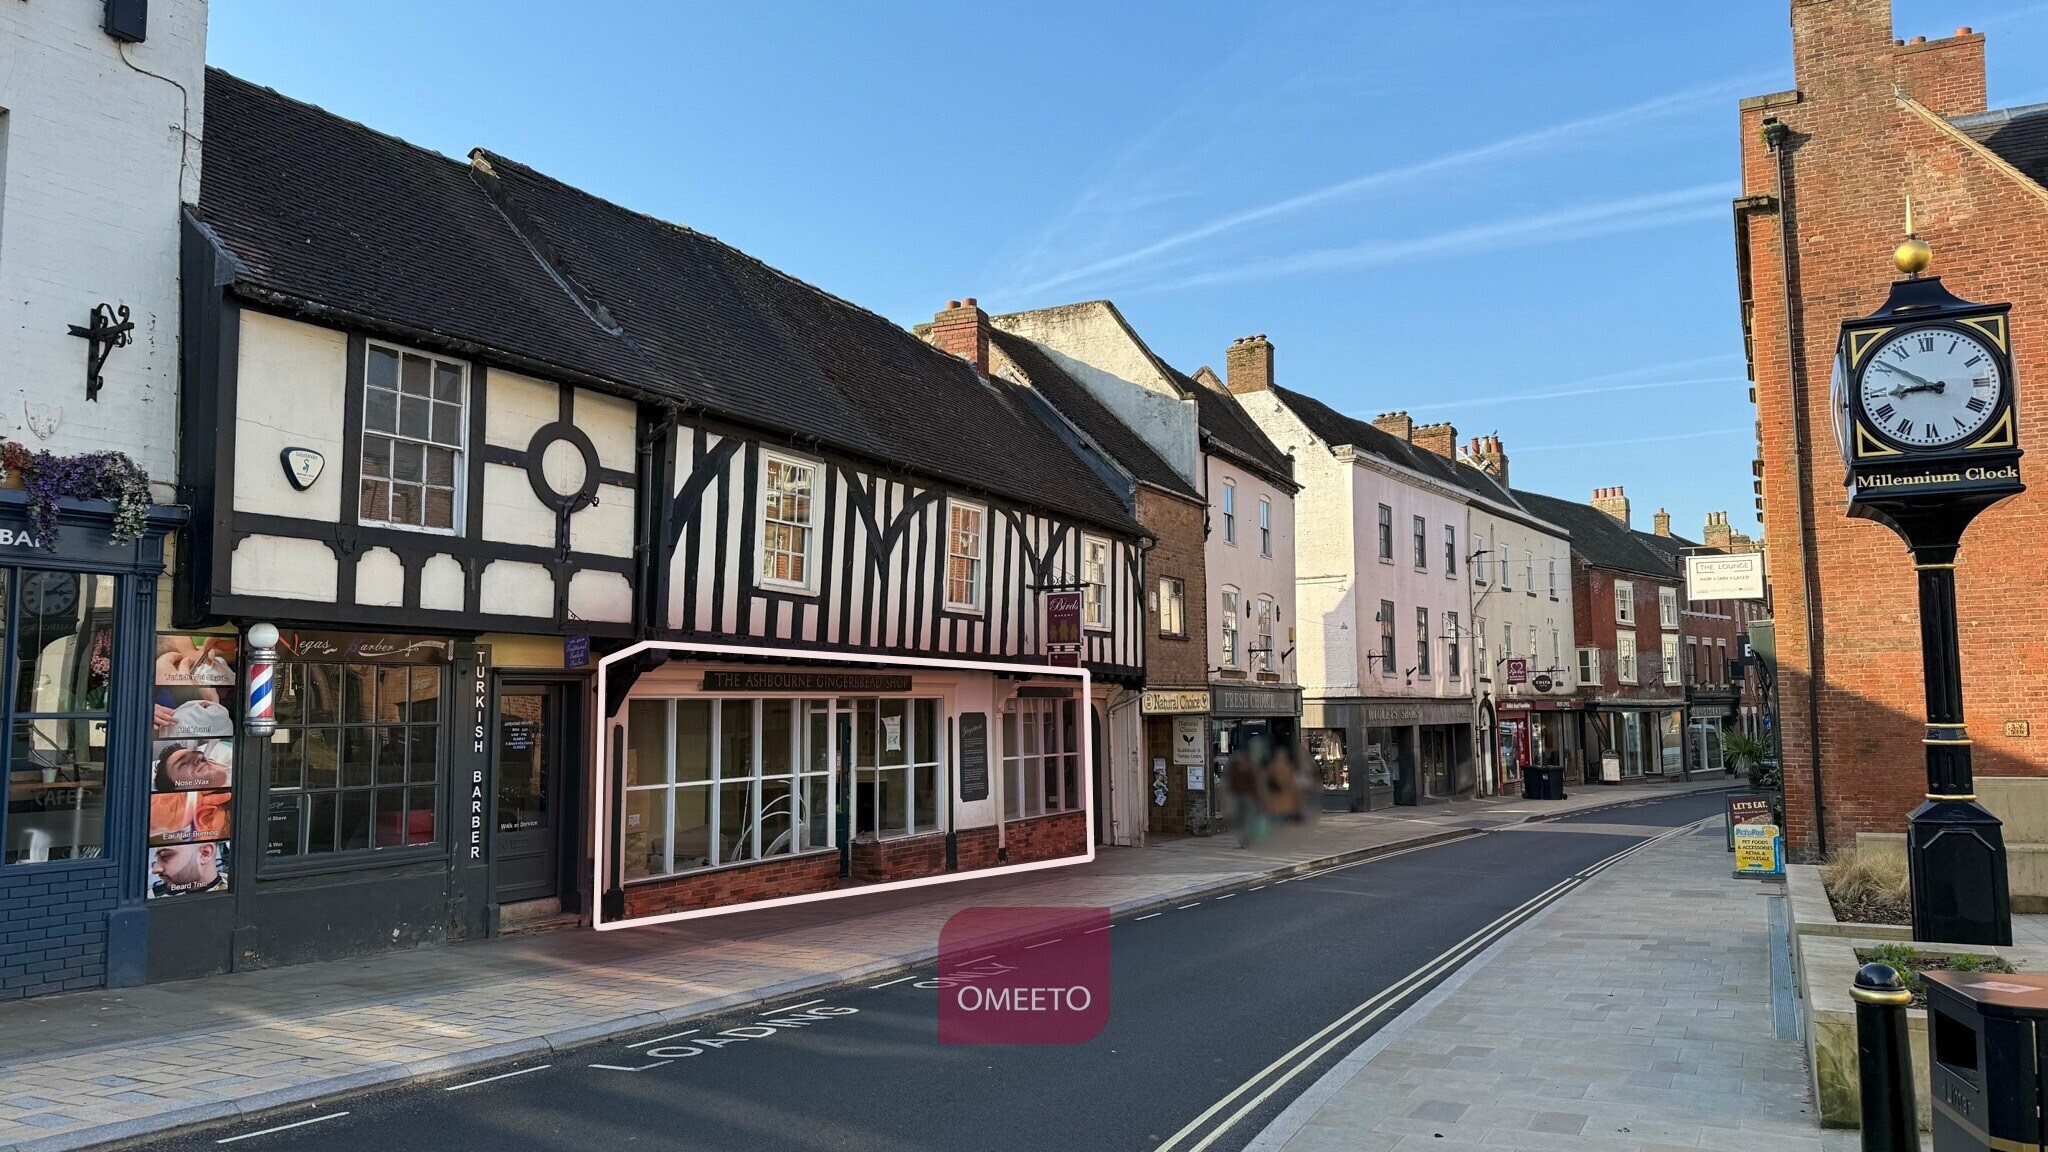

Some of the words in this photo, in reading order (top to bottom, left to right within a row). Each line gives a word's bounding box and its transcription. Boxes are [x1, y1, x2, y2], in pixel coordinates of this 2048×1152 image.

[1857, 472, 1961, 488] Millennium
[1965, 466, 2018, 480] Clock
[0, 528, 40, 548] BA
[1049, 598, 1078, 612] Birds
[279, 634, 332, 656] Vegas
[715, 672, 740, 687] THE
[745, 674, 811, 688] ASHBOURNE
[816, 675, 882, 688] GINGERBREAD
[885, 678, 909, 689] SHOP
[474, 652, 486, 752] TURKISH
[1154, 694, 1178, 711] Natural
[1180, 694, 1200, 709] Choice
[1224, 692, 1248, 708] FRESH
[1250, 693, 1275, 708] CHOICE
[470, 770, 482, 858] BARBER
[171, 882, 191, 891] Beard
[588, 1006, 860, 1072] LOADING
